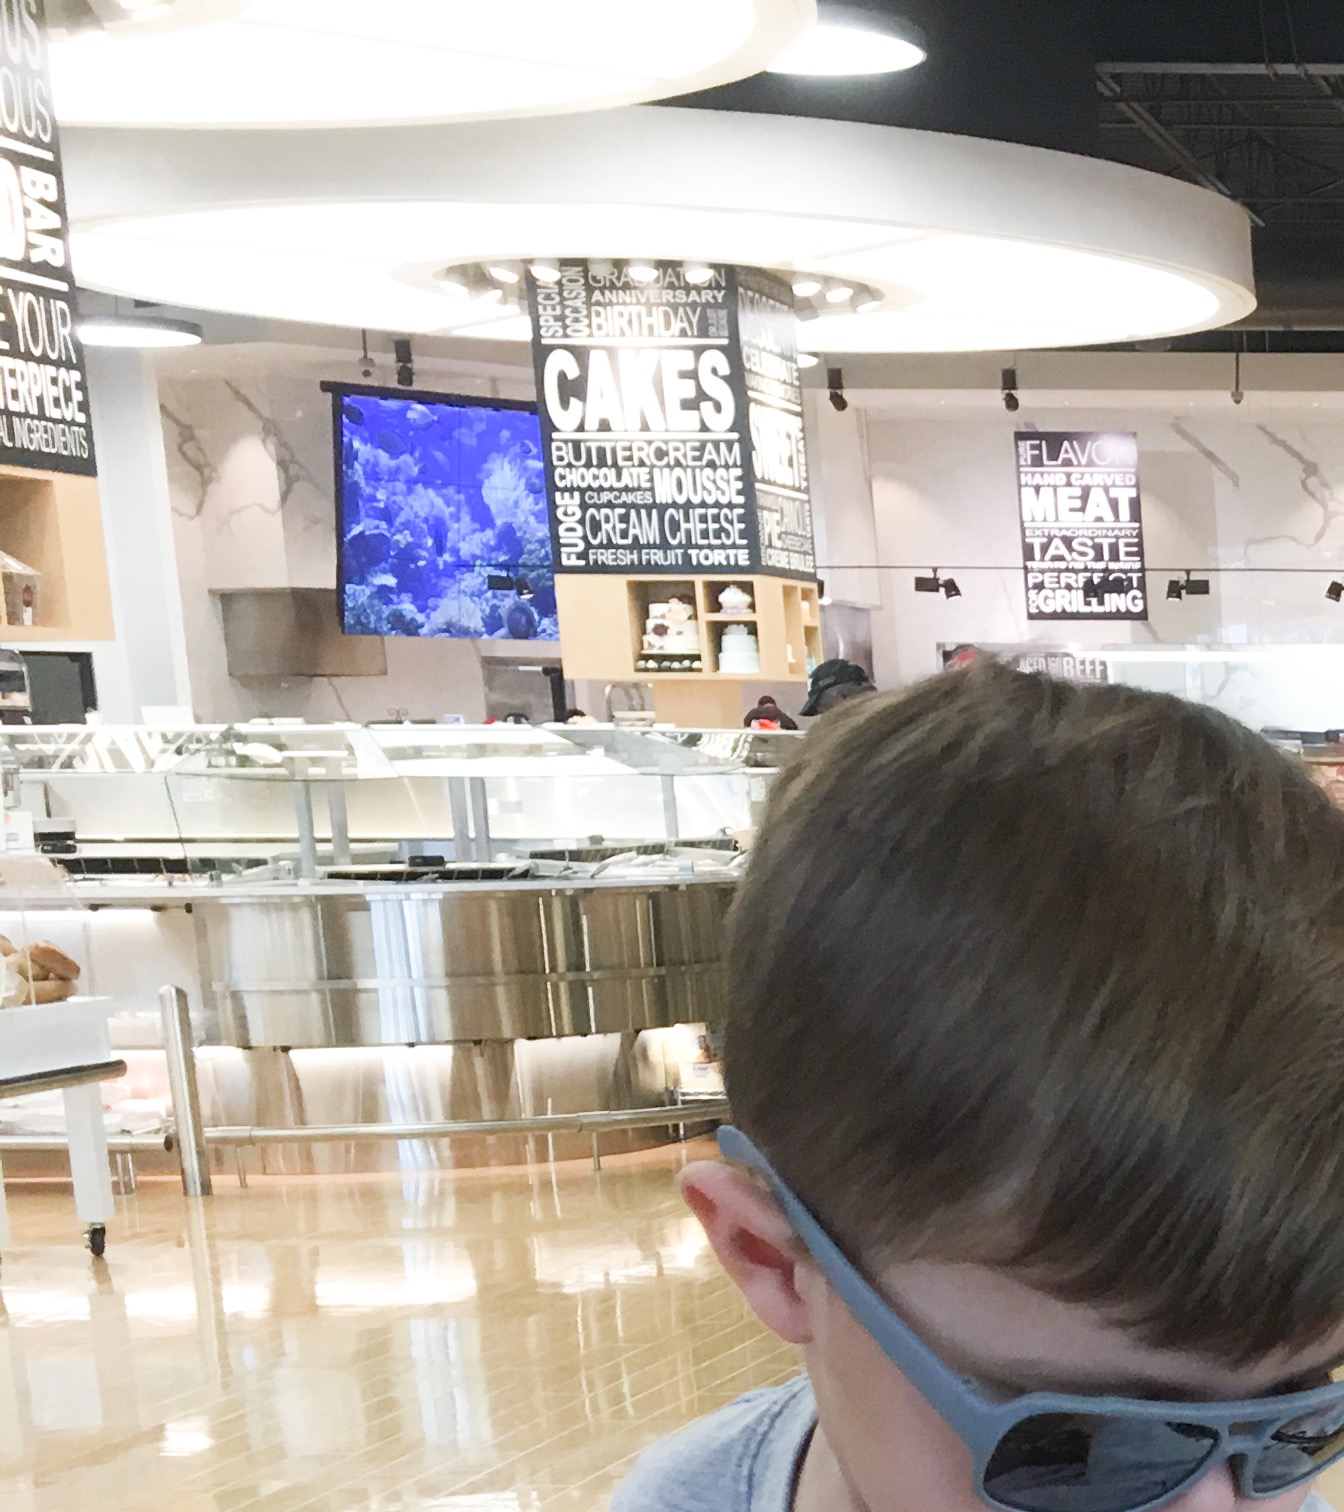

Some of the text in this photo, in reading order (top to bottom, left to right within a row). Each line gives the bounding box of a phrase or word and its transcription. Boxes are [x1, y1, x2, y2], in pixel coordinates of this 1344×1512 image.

[20, 165, 65, 267] BAR
[537, 278, 563, 338] SPECIA
[561, 266, 591, 338] OCCASION
[590, 289, 726, 304] ANNIVERSARY
[7, 288, 77, 364] YOUR
[590, 305, 703, 337] BIRTHDAY
[544, 349, 736, 433] CAKES
[13, 416, 89, 460] INGREDIENTS
[551, 441, 741, 466] BUTTERCREAM
[554, 467, 651, 488] CHOCOLATE
[653, 467, 746, 505] MOUSSE
[1020, 473, 1137, 486] HAND CARVED
[585, 491, 653, 504] CUPCAKES
[1021, 487, 1137, 522] MEAT
[555, 491, 586, 566] FUDGE
[586, 507, 660, 545] CREAM
[664, 507, 748, 546] CHEESE
[1025, 528, 1140, 537] EXTRAORDINARY
[589, 548, 750, 566] FRESH FRUIT TORTE
[1025, 537, 1141, 561] TASTE
[1037, 589, 1145, 613] GRILLING
[1063, 657, 1105, 679] BEEF
